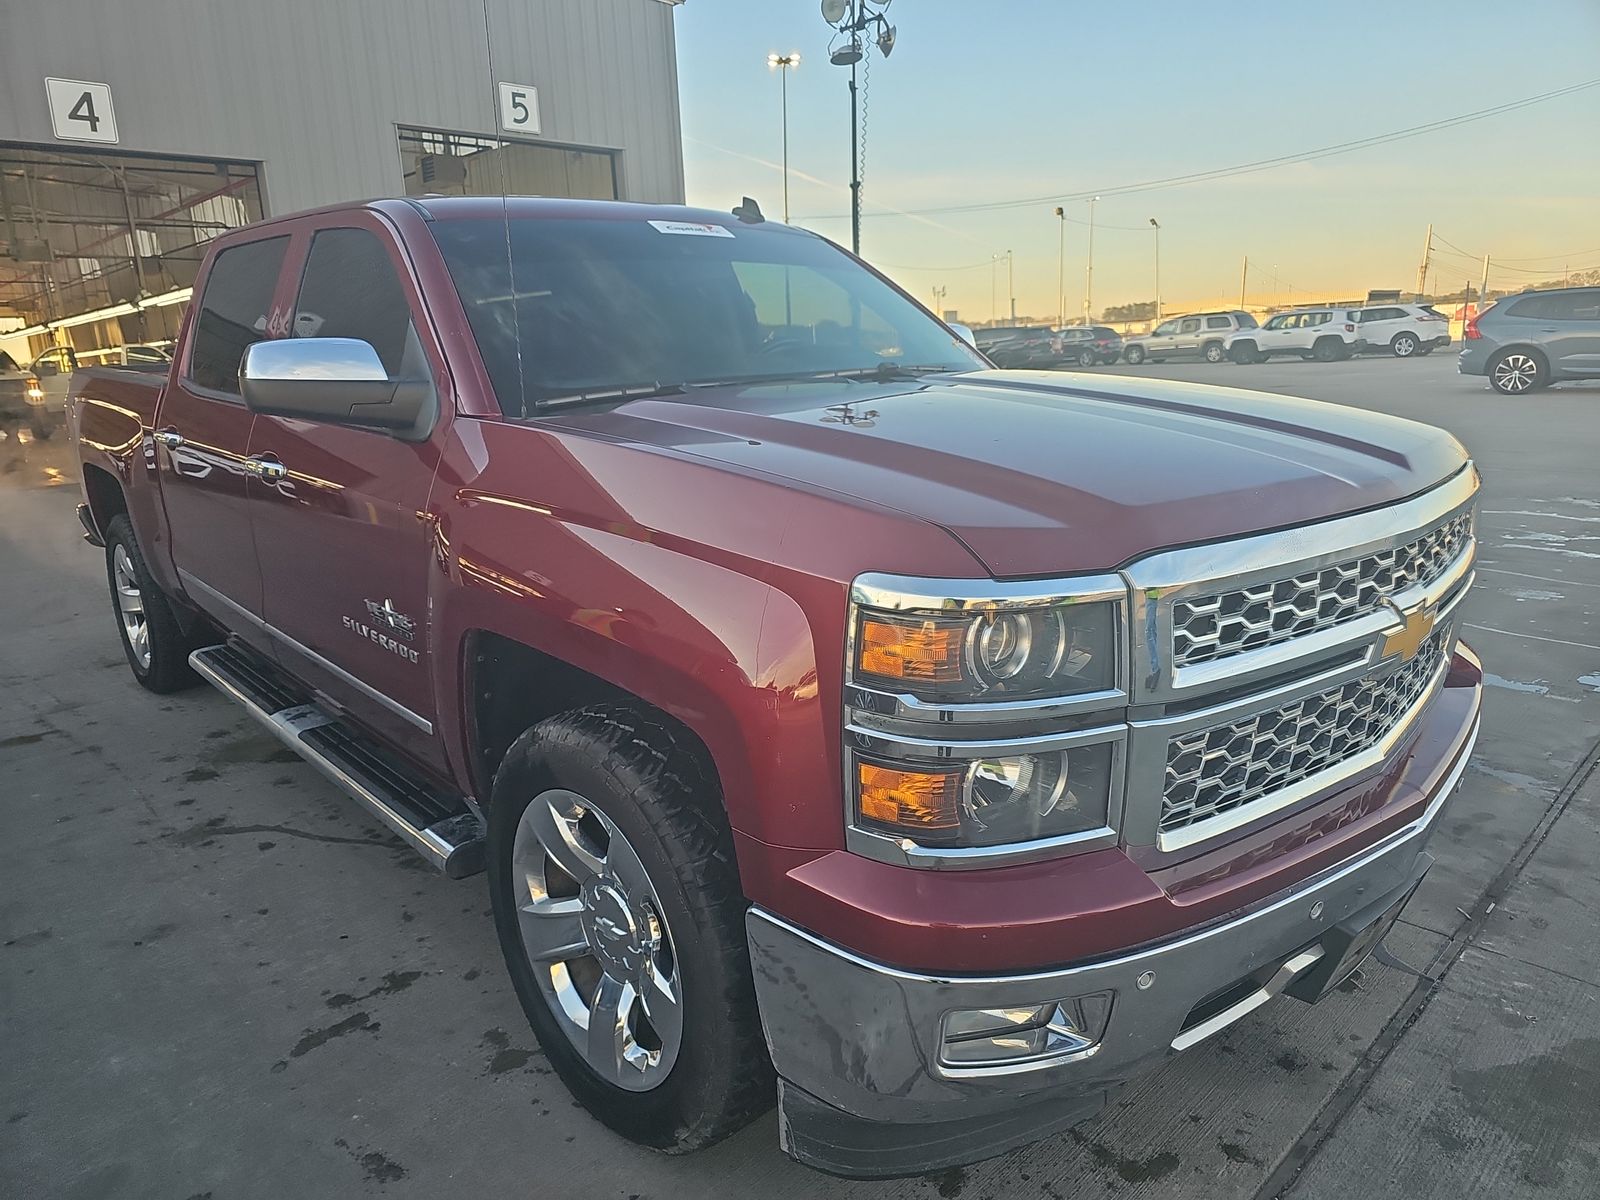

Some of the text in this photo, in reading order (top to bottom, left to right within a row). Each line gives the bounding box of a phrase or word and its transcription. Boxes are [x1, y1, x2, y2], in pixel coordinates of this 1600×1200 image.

[68, 92, 100, 132] 4
[511, 91, 529, 124] 5
[342, 615, 419, 664] SILVERADO
